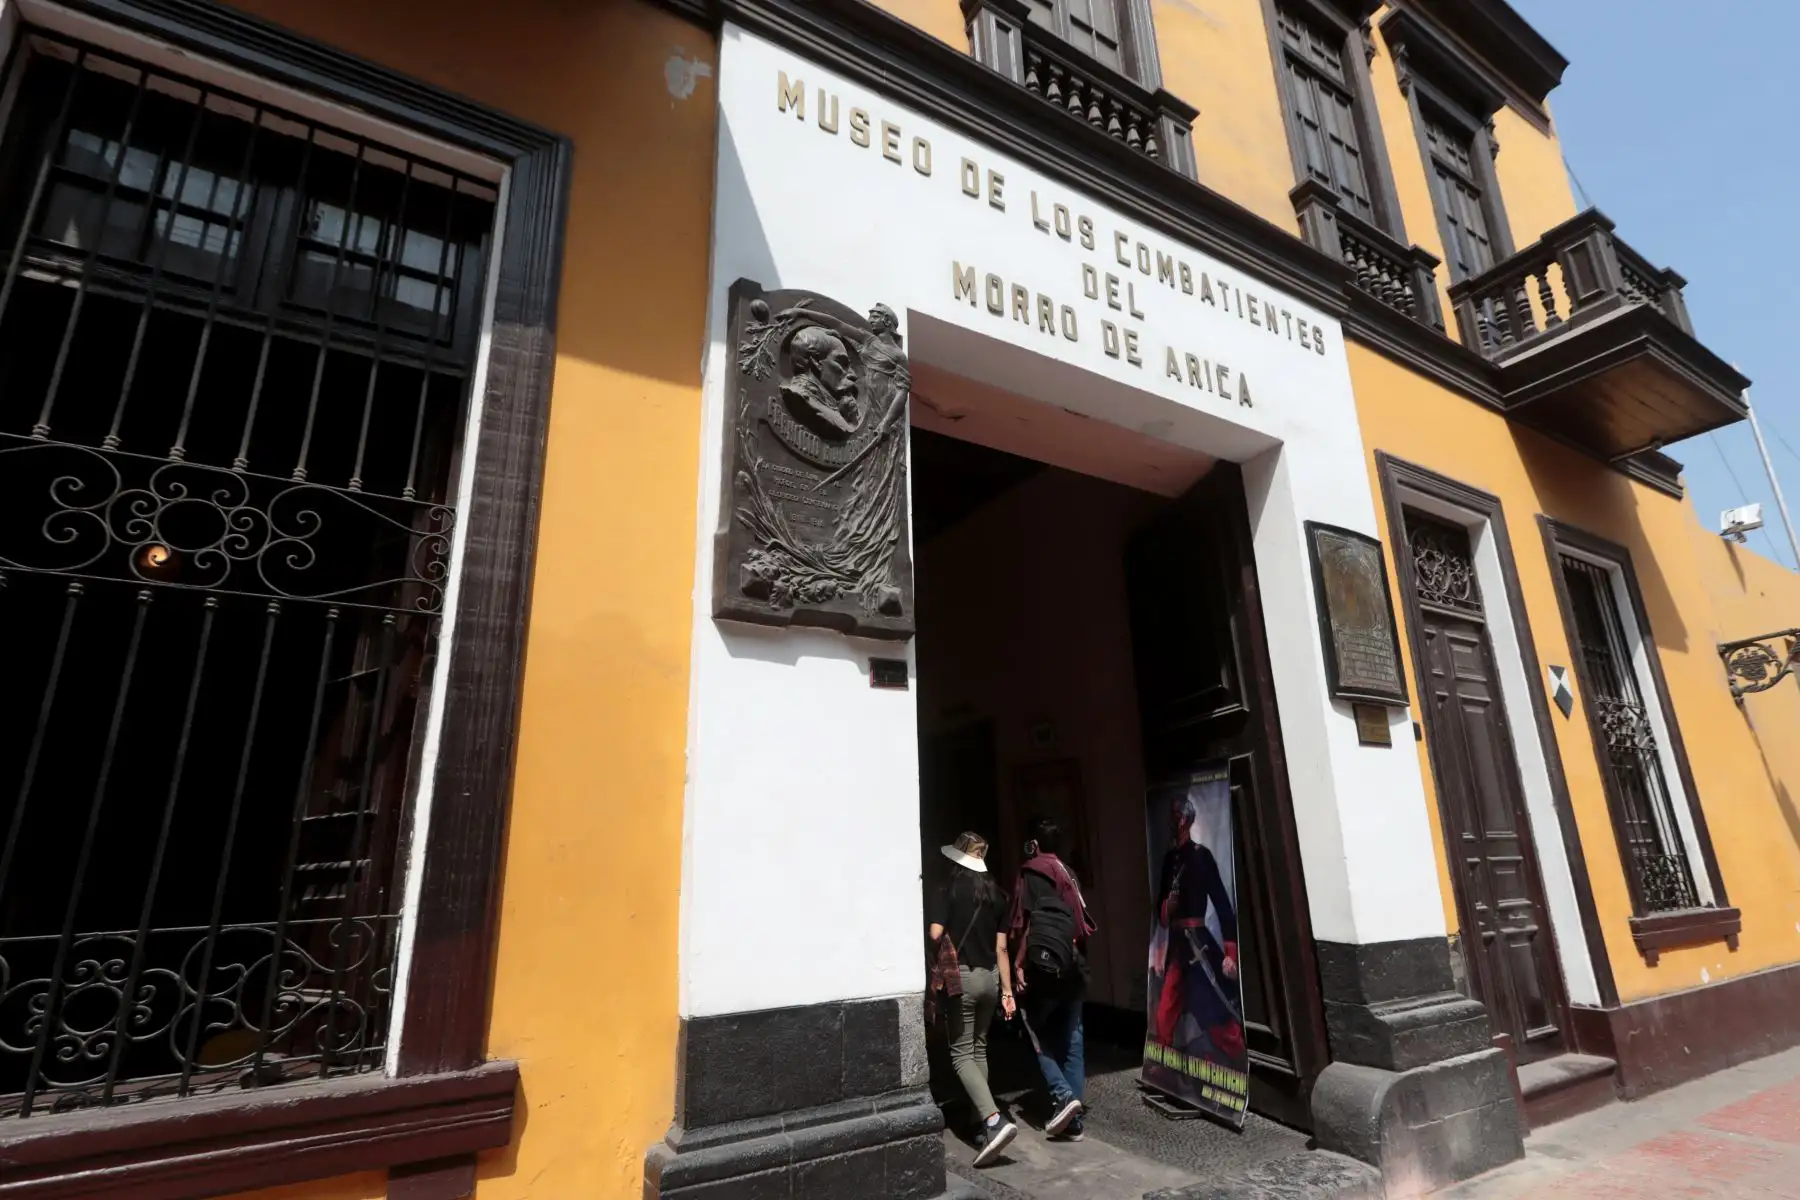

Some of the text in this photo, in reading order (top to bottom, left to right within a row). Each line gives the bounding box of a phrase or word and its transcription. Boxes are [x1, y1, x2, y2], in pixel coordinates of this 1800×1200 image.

[778, 70, 1326, 357] MUSEO DE LOS COMBATIENTES
[952, 260, 1255, 409] MORRO DE ARICA
[1081, 262, 1145, 321] DEL
